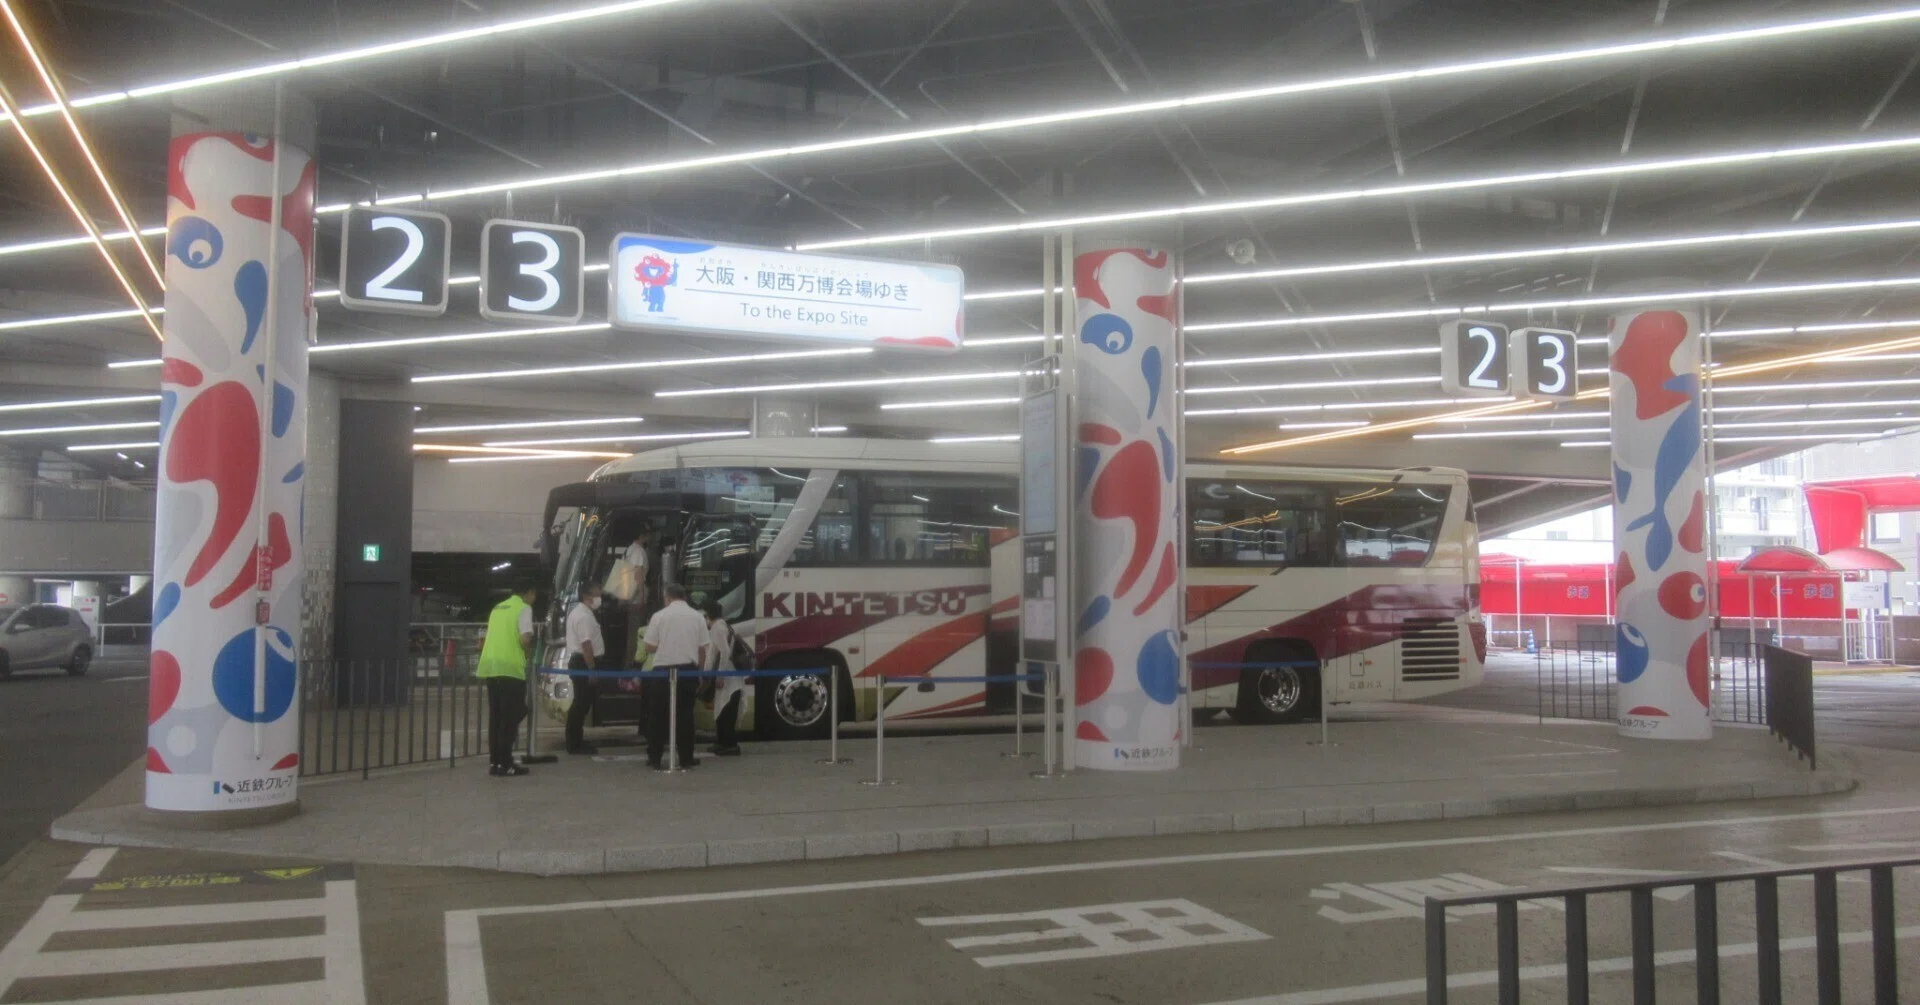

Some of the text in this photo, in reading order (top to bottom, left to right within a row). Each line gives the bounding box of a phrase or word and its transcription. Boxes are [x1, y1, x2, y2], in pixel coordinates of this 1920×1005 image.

[366, 217, 424, 302] 2
[508, 231, 560, 311] 3
[696, 265, 908, 301] 大阪・関西万博会場ゆき
[740, 303, 868, 326] To the Expo Site
[1468, 327, 1498, 388] 2
[1538, 335, 1566, 393] 3
[763, 592, 967, 618] KINTETSU
